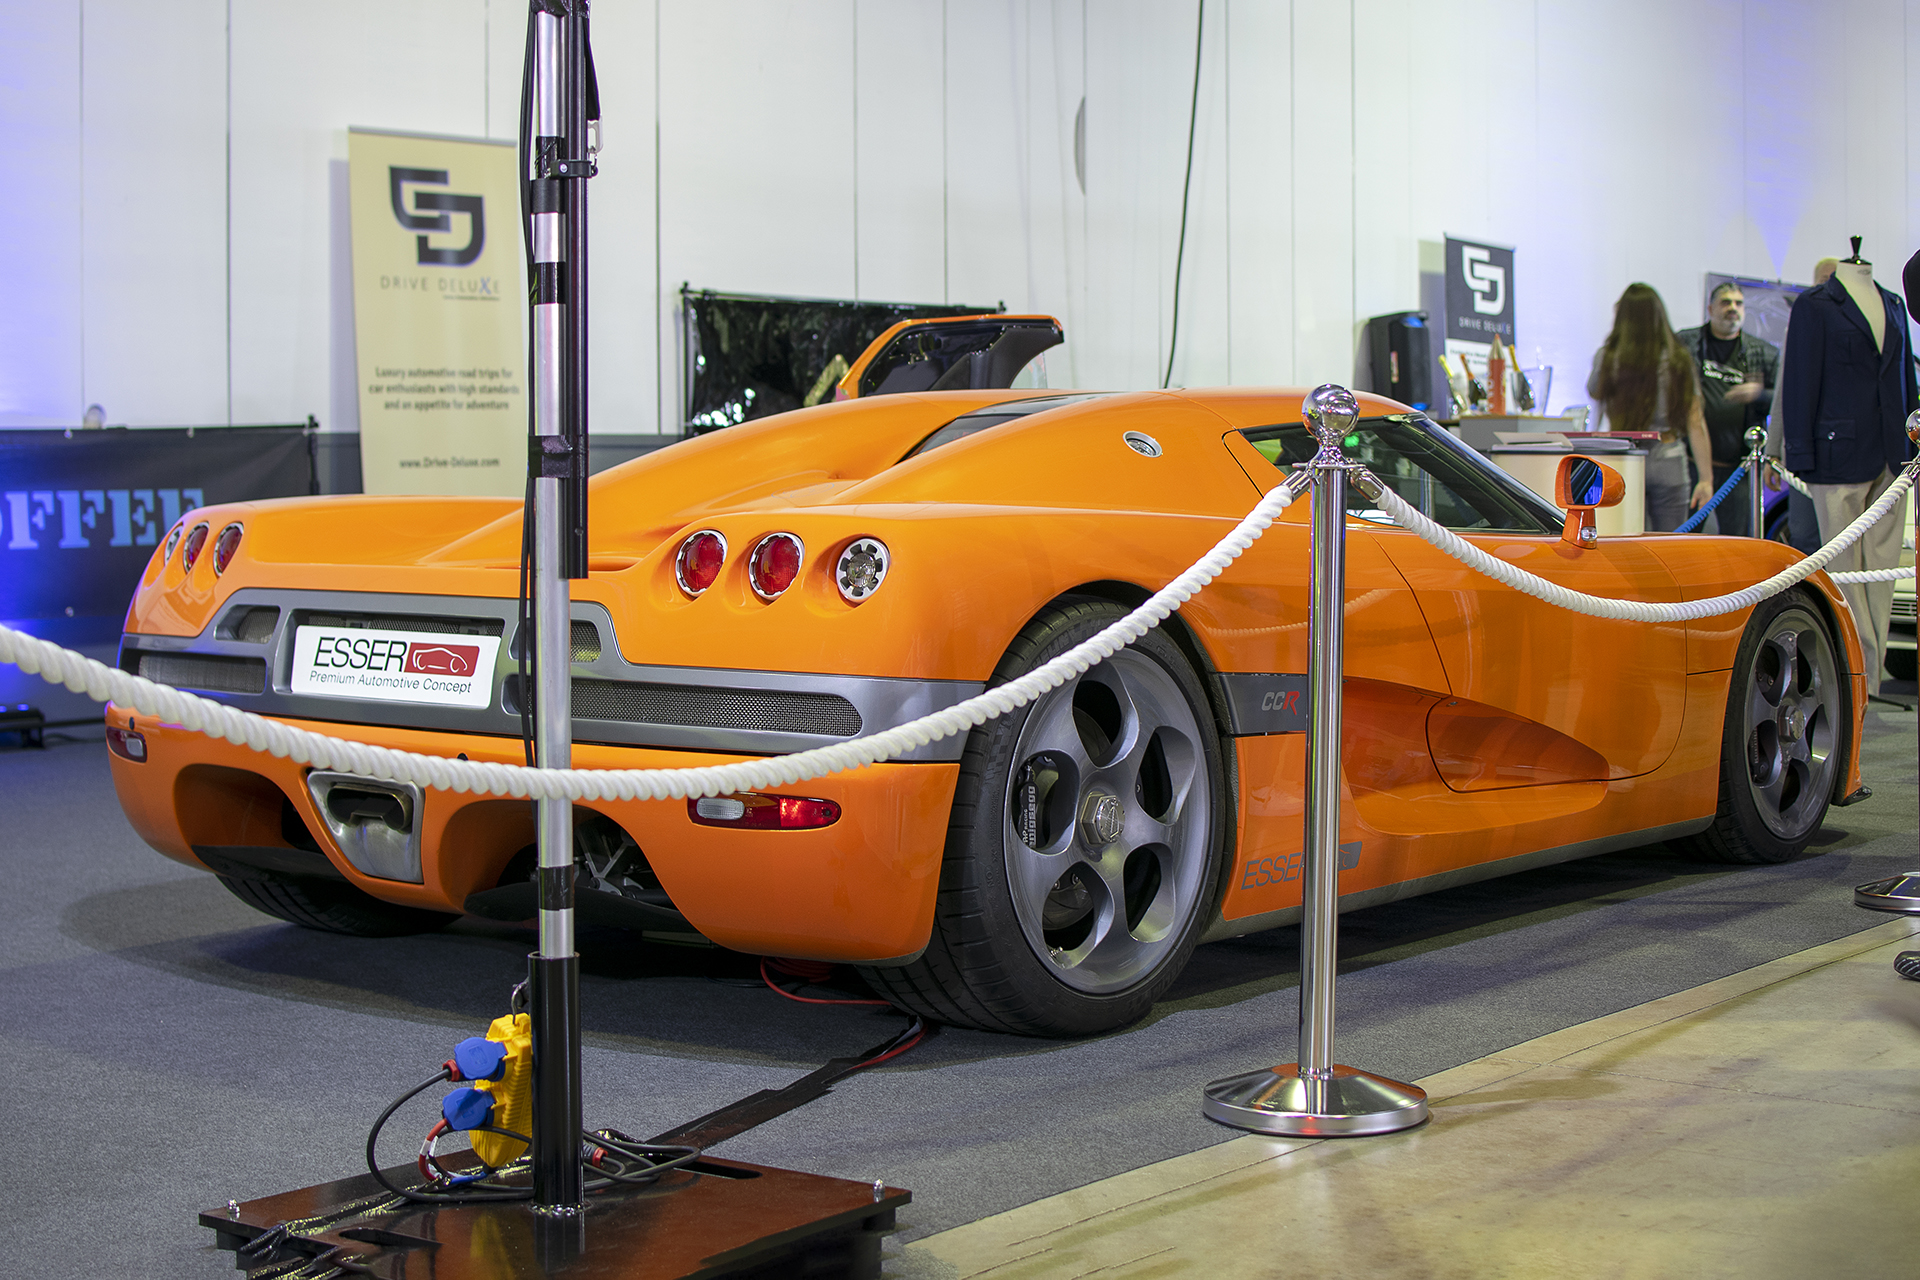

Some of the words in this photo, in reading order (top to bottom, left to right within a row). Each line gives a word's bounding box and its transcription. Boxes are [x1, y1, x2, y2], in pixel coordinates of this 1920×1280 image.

[380, 275, 428, 291] DRIVE
[438, 277, 500, 295] DELUXE
[1458, 316, 1481, 330] DRIVE
[375, 366, 405, 379] Luxury
[408, 367, 456, 378] automotive
[459, 367, 476, 378] road
[478, 368, 500, 380] trips
[368, 384, 383, 394] car
[386, 383, 436, 394] enthusiasts
[439, 383, 456, 394] with
[459, 384, 476, 396] high
[479, 384, 520, 395] standards
[384, 400, 400, 410] and
[414, 400, 451, 411] appetite
[466, 400, 509, 410] adventure
[313, 636, 408, 672] ESSER
[309, 669, 355, 685] Premium
[357, 673, 420, 690] Automotive
[422, 678, 472, 695] Concept
[1261, 690, 1300, 716] CCR
[1241, 851, 1304, 890] ESSE
